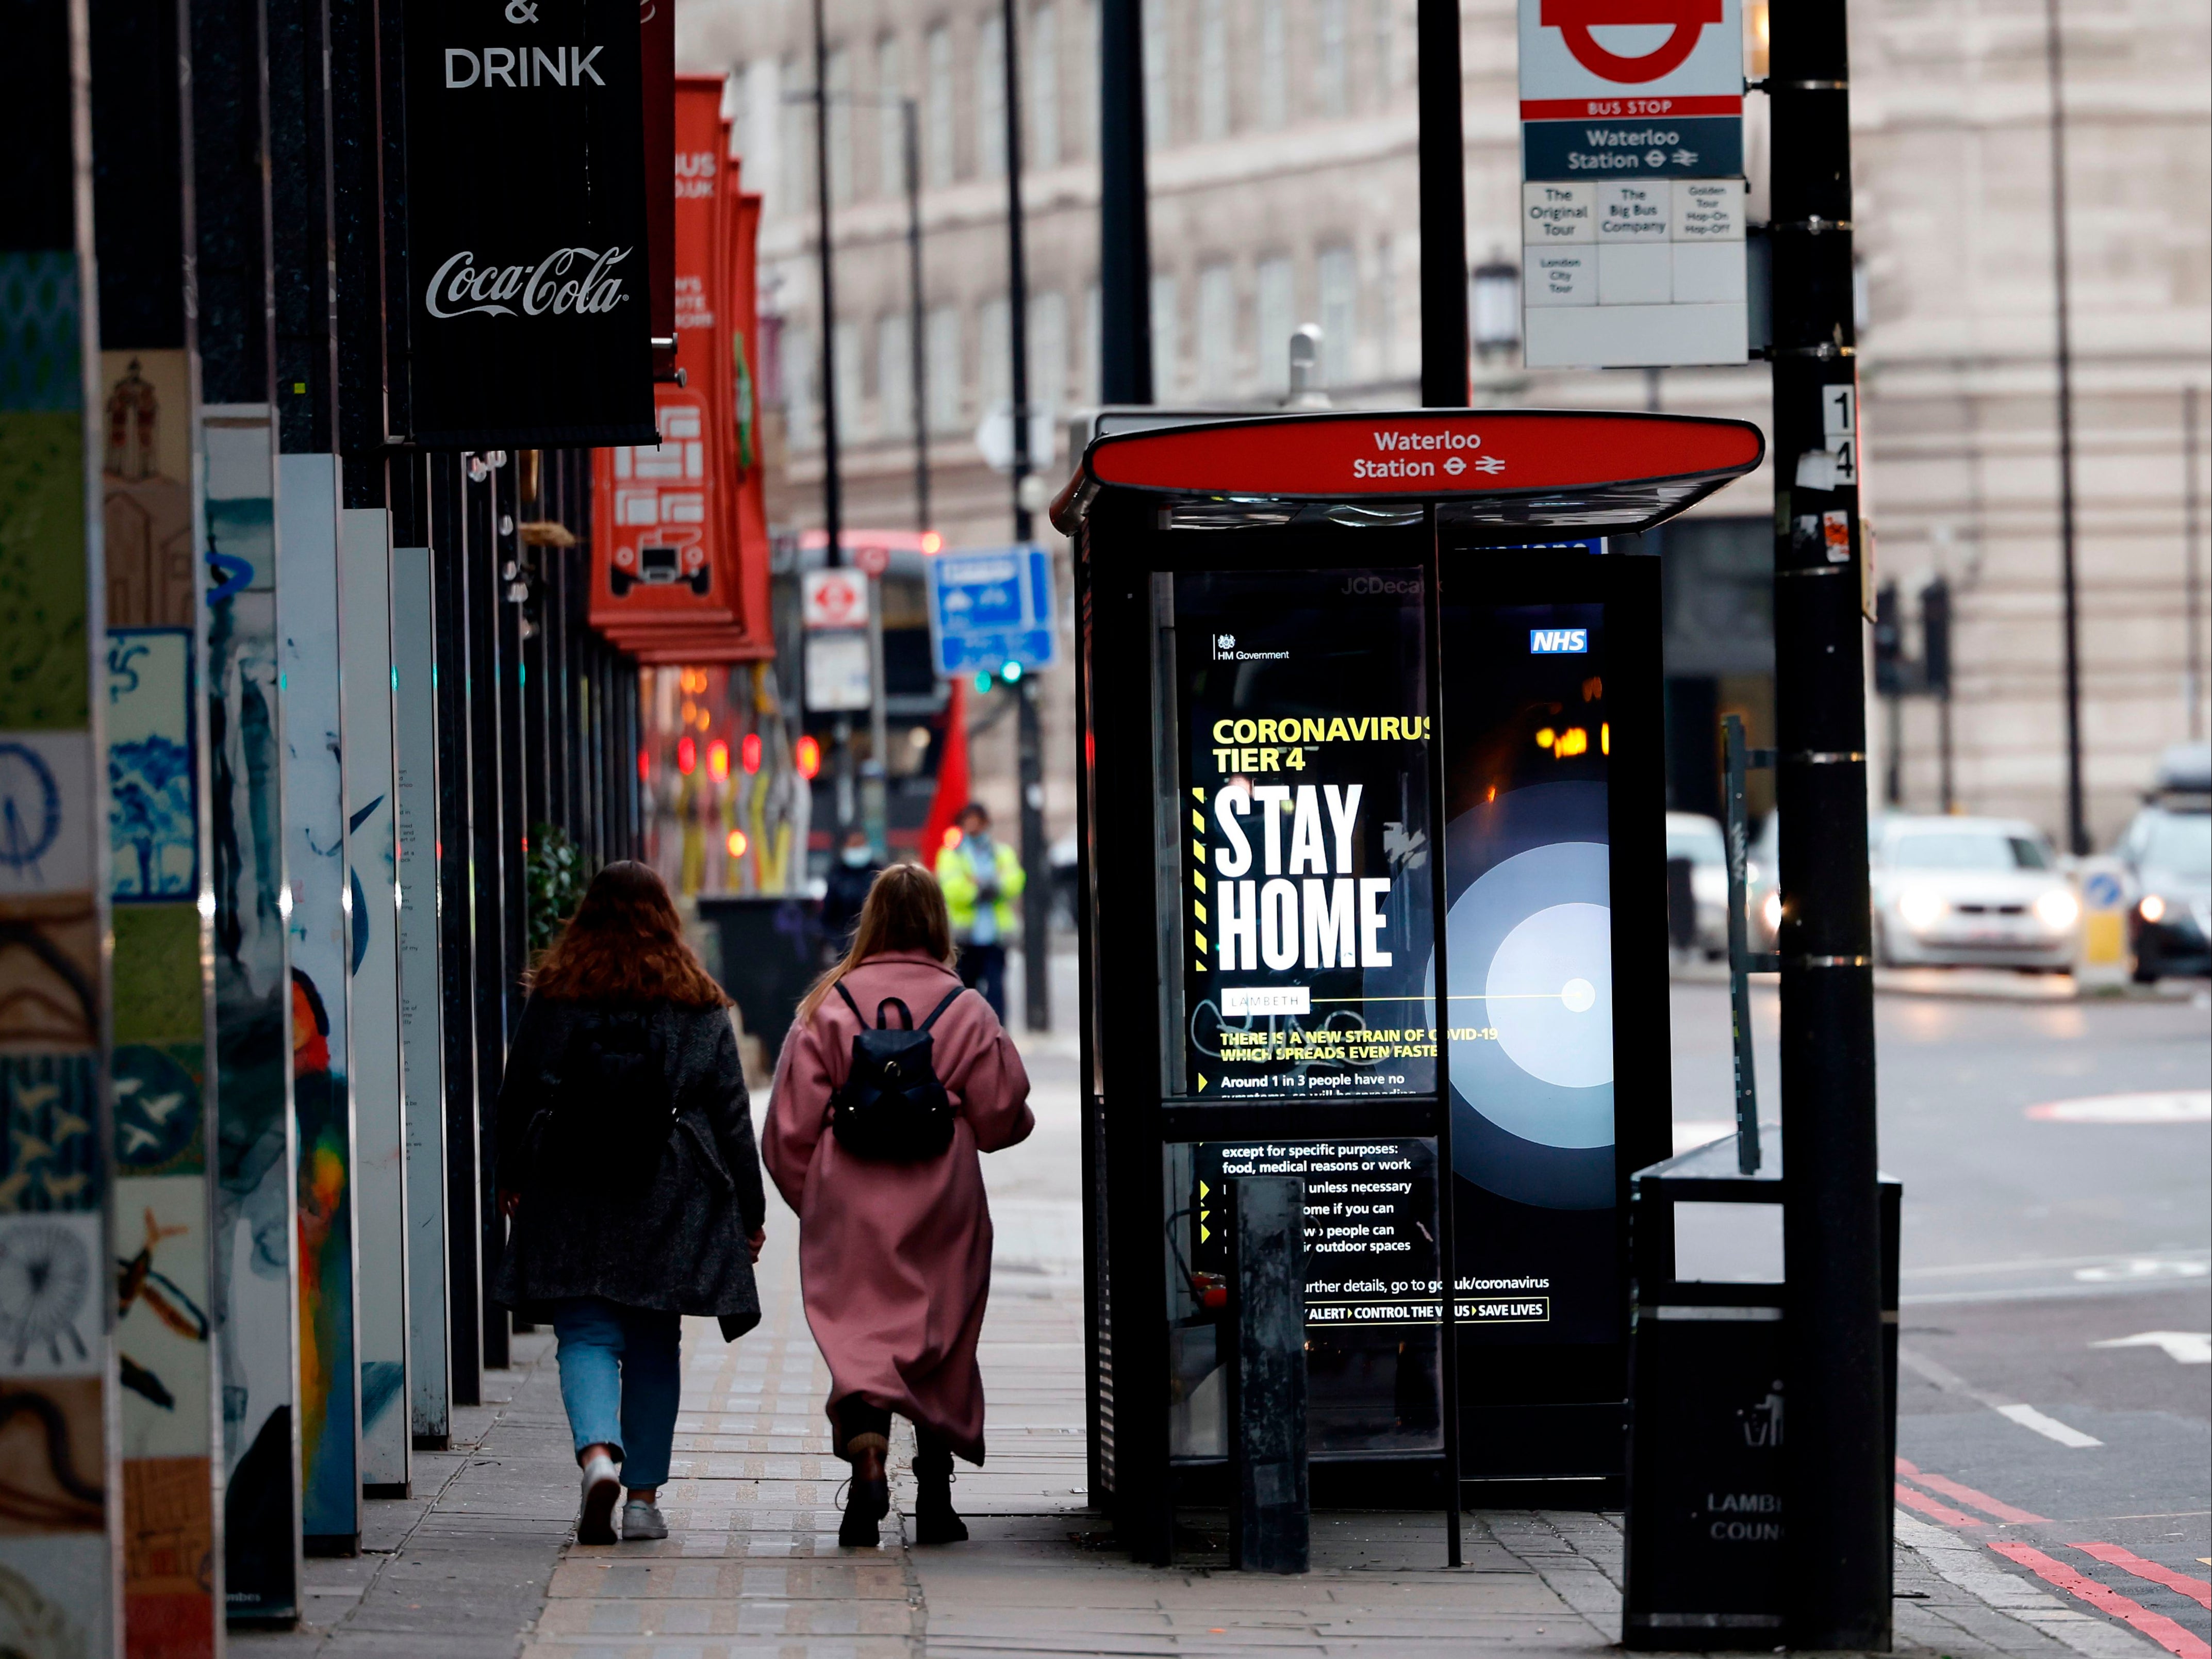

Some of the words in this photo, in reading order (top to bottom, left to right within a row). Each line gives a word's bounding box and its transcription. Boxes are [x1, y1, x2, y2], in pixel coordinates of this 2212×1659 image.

[444, 45, 606, 89] DRINK
[1588, 101, 1621, 115] BUS
[1627, 100, 1672, 114] STOP
[1586, 129, 1680, 146] Waterloo
[1567, 151, 1639, 169] Station
[1545, 189, 1573, 202] The
[1621, 189, 1646, 201] The
[1530, 206, 1588, 222] Original
[1609, 205, 1630, 219] Big
[1633, 204, 1658, 216] Bus
[1543, 222, 1576, 236] Tour
[1602, 221, 1666, 234] Company
[425, 246, 634, 318] Coca-Cola
[1373, 430, 1481, 451] Waterloo
[1353, 457, 1435, 479] Station
[1340, 577, 1444, 595] JCDeca
[1532, 631, 1585, 651] NHS
[1218, 651, 1233, 660] HM
[1236, 651, 1290, 660] Government
[1213, 748, 1280, 773] TIER
[1285, 747, 1306, 771] 4
[1214, 784, 1363, 877] STAY
[1217, 878, 1393, 971] HOME
[1231, 996, 1298, 1007] LAMBETH
[1220, 1032, 1268, 1045] THERE
[1272, 1032, 1285, 1044] IS
[1290, 1031, 1302, 1044] A
[1306, 1031, 1342, 1044] NEW
[1345, 1030, 1400, 1043] STRAIN
[1404, 1029, 1425, 1042] OF
[1428, 1028, 1498, 1041] CVID-19
[1220, 1048, 1272, 1061] WHICH
[1276, 1046, 1345, 1060] SPREADS
[1349, 1045, 1390, 1059] EVEN
[1394, 1045, 1438, 1058] FASTE
[1220, 1075, 1268, 1088] Around
[1272, 1075, 1278, 1087] 1
[1283, 1075, 1294, 1087] in
[1298, 1075, 1306, 1086] 3
[1309, 1073, 1351, 1088] people
[1355, 1073, 1385, 1085] have
[1389, 1075, 1405, 1084] no
[1222, 1146, 1264, 1160] except
[1267, 1145, 1286, 1157] for
[1289, 1143, 1335, 1159] specific
[1338, 1144, 1398, 1158] purposes:
[1222, 1161, 1256, 1175] food,
[1259, 1160, 1307, 1173] medical
[1311, 1161, 1359, 1172] reasons
[1361, 1161, 1375, 1171] or
[1378, 1158, 1411, 1171] work
[1309, 1181, 1348, 1194] unless
[1351, 1181, 1412, 1194] necessary
[1303, 1204, 1330, 1215] ome
[1333, 1203, 1343, 1214] if
[1345, 1204, 1369, 1217] you
[1372, 1204, 1394, 1214] can
[1303, 1227, 1324, 1237] wo
[1327, 1224, 1370, 1239] people
[1372, 1225, 1395, 1236] can
[1315, 1240, 1367, 1253] outdoor
[1369, 1241, 1411, 1254] spaces
[1305, 1279, 1341, 1293] urther
[1343, 1278, 1388, 1293] details,
[1391, 1280, 1408, 1294] go
[1411, 1279, 1425, 1291] to
[1309, 1308, 1346, 1320] ALERT
[1354, 1306, 1410, 1319] CONTROL
[1411, 1306, 1434, 1318] THE
[1434, 1305, 1470, 1318] VUS
[1478, 1304, 1509, 1317] SAVE
[1511, 1304, 1543, 1316] LIVES
[1710, 1521, 1786, 1541] COUN
